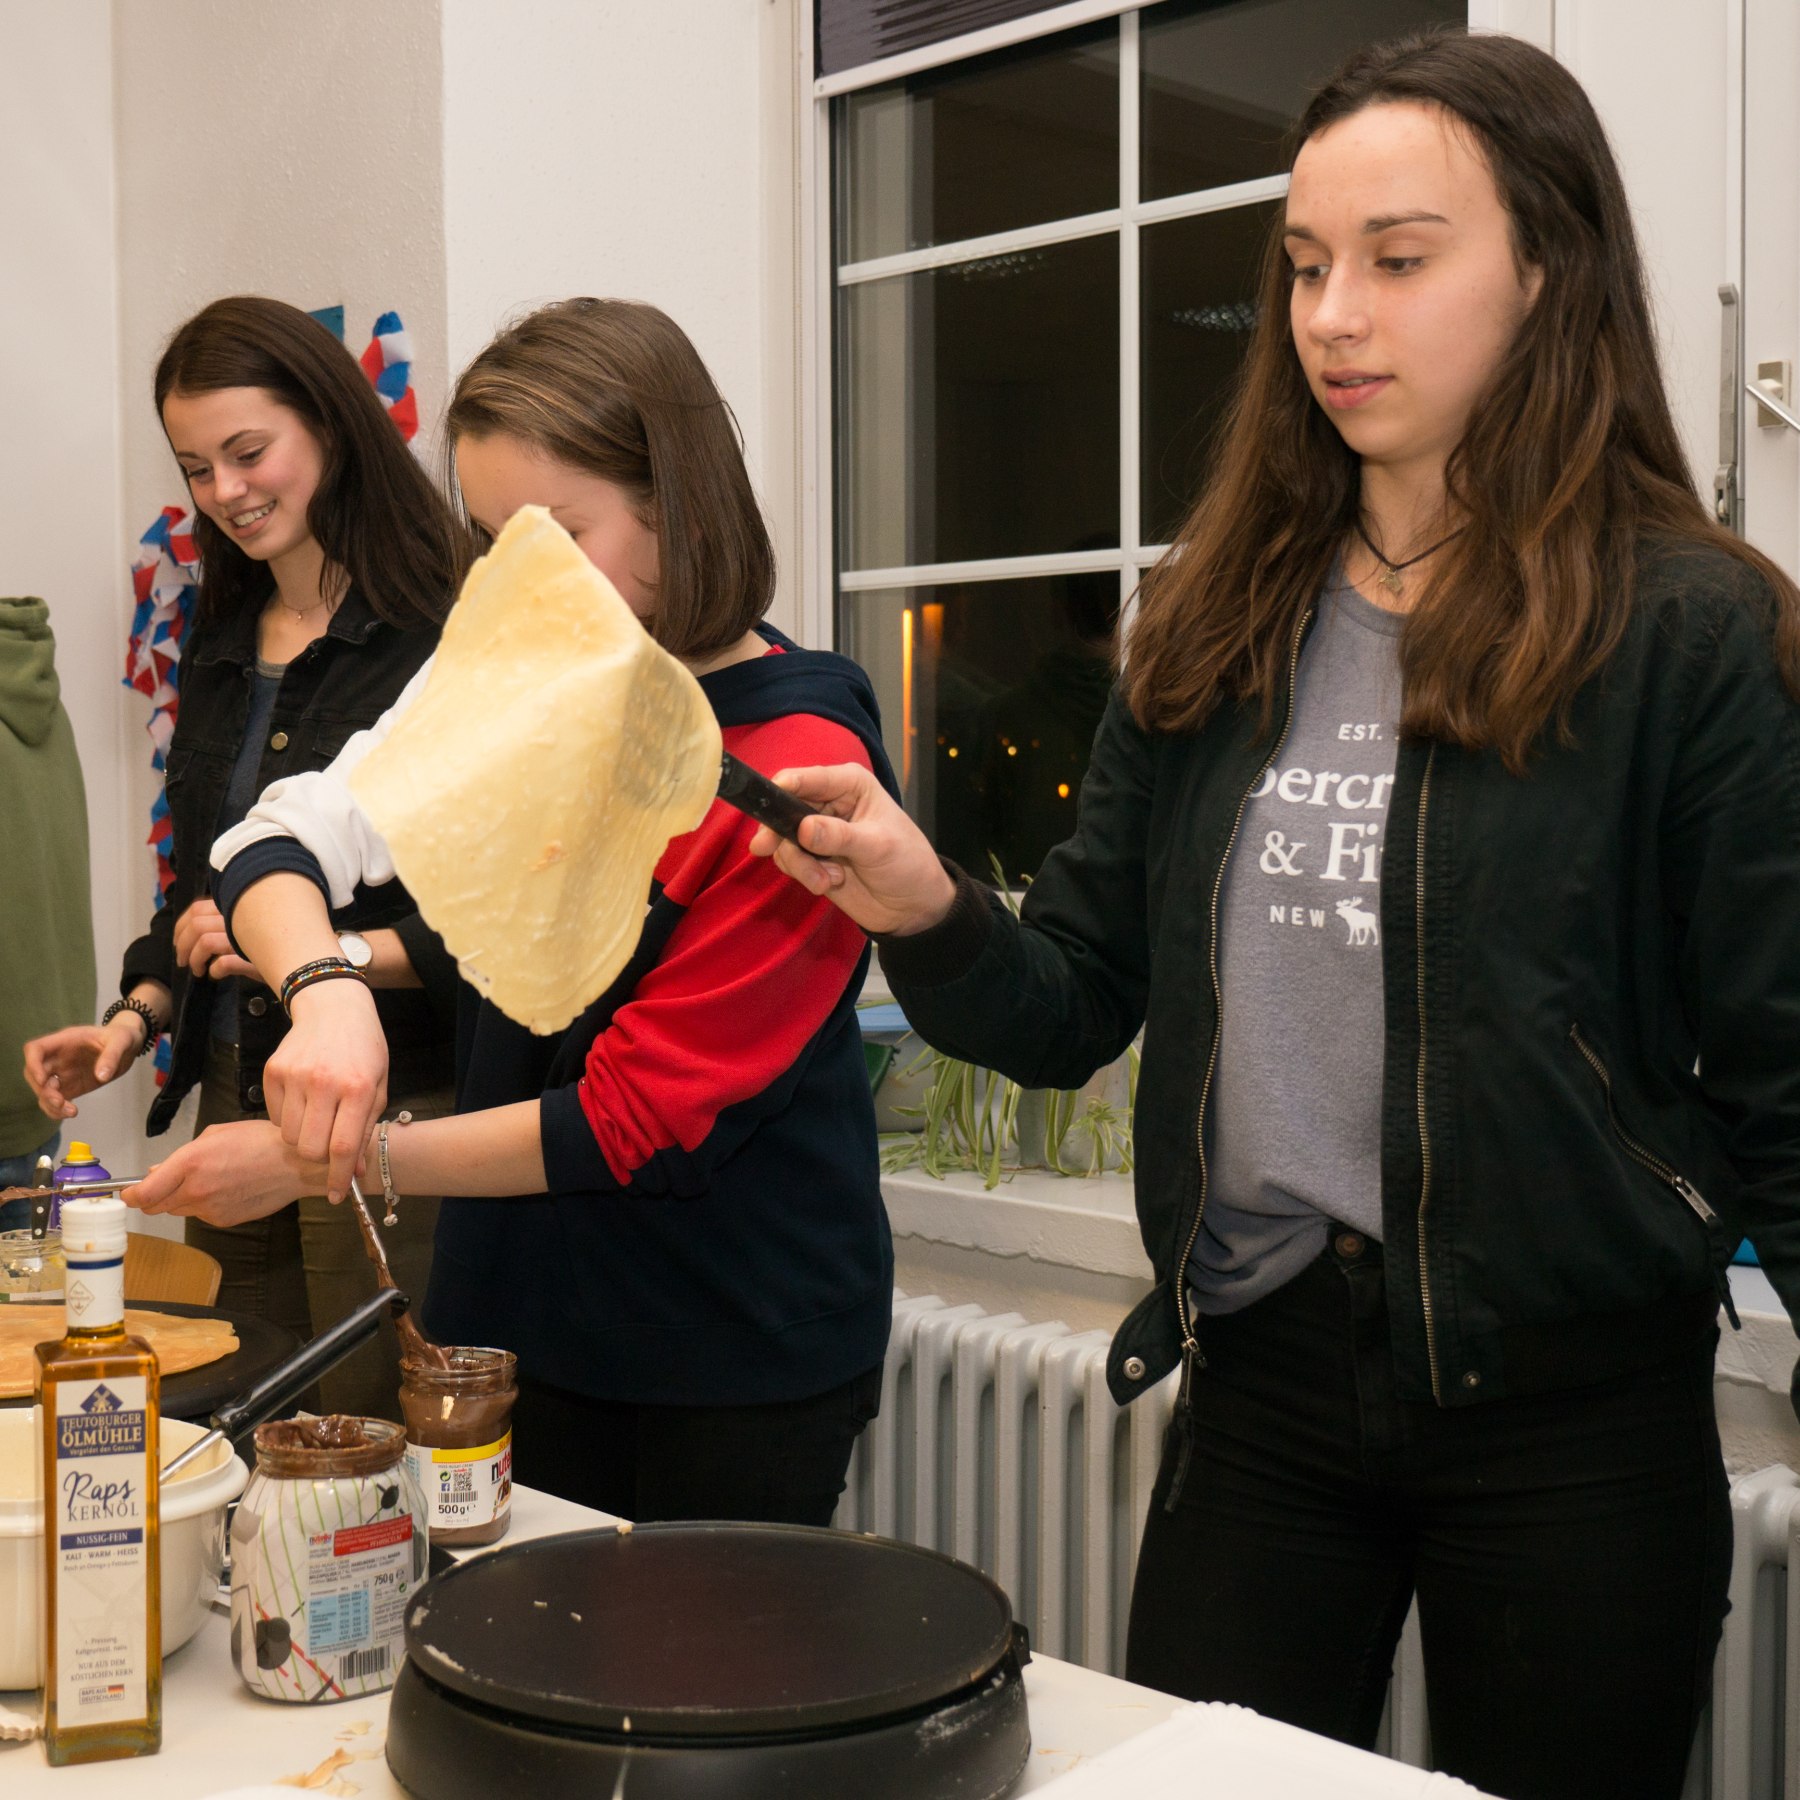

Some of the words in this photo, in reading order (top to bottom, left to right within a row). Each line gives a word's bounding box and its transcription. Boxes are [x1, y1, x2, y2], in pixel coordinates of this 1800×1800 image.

[1338, 723, 1382, 741] EST.
[1259, 830, 1306, 876] &
[1319, 822, 1384, 882] Fi
[1270, 905, 1325, 928] NEW
[62, 1413, 142, 1430] TEUTOBURGER
[61, 1425, 142, 1448] ÖLMÜHLE
[63, 1471, 136, 1511] Raps
[68, 1500, 139, 1522] KERNÖL
[76, 1532, 128, 1545] NUSSIG-FEIN
[65, 1552, 82, 1561] KALT
[88, 1550, 111, 1559] WARM
[117, 1547, 139, 1555] HEISS
[94, 1660, 109, 1668] AUS
[110, 1658, 126, 1666] DEM
